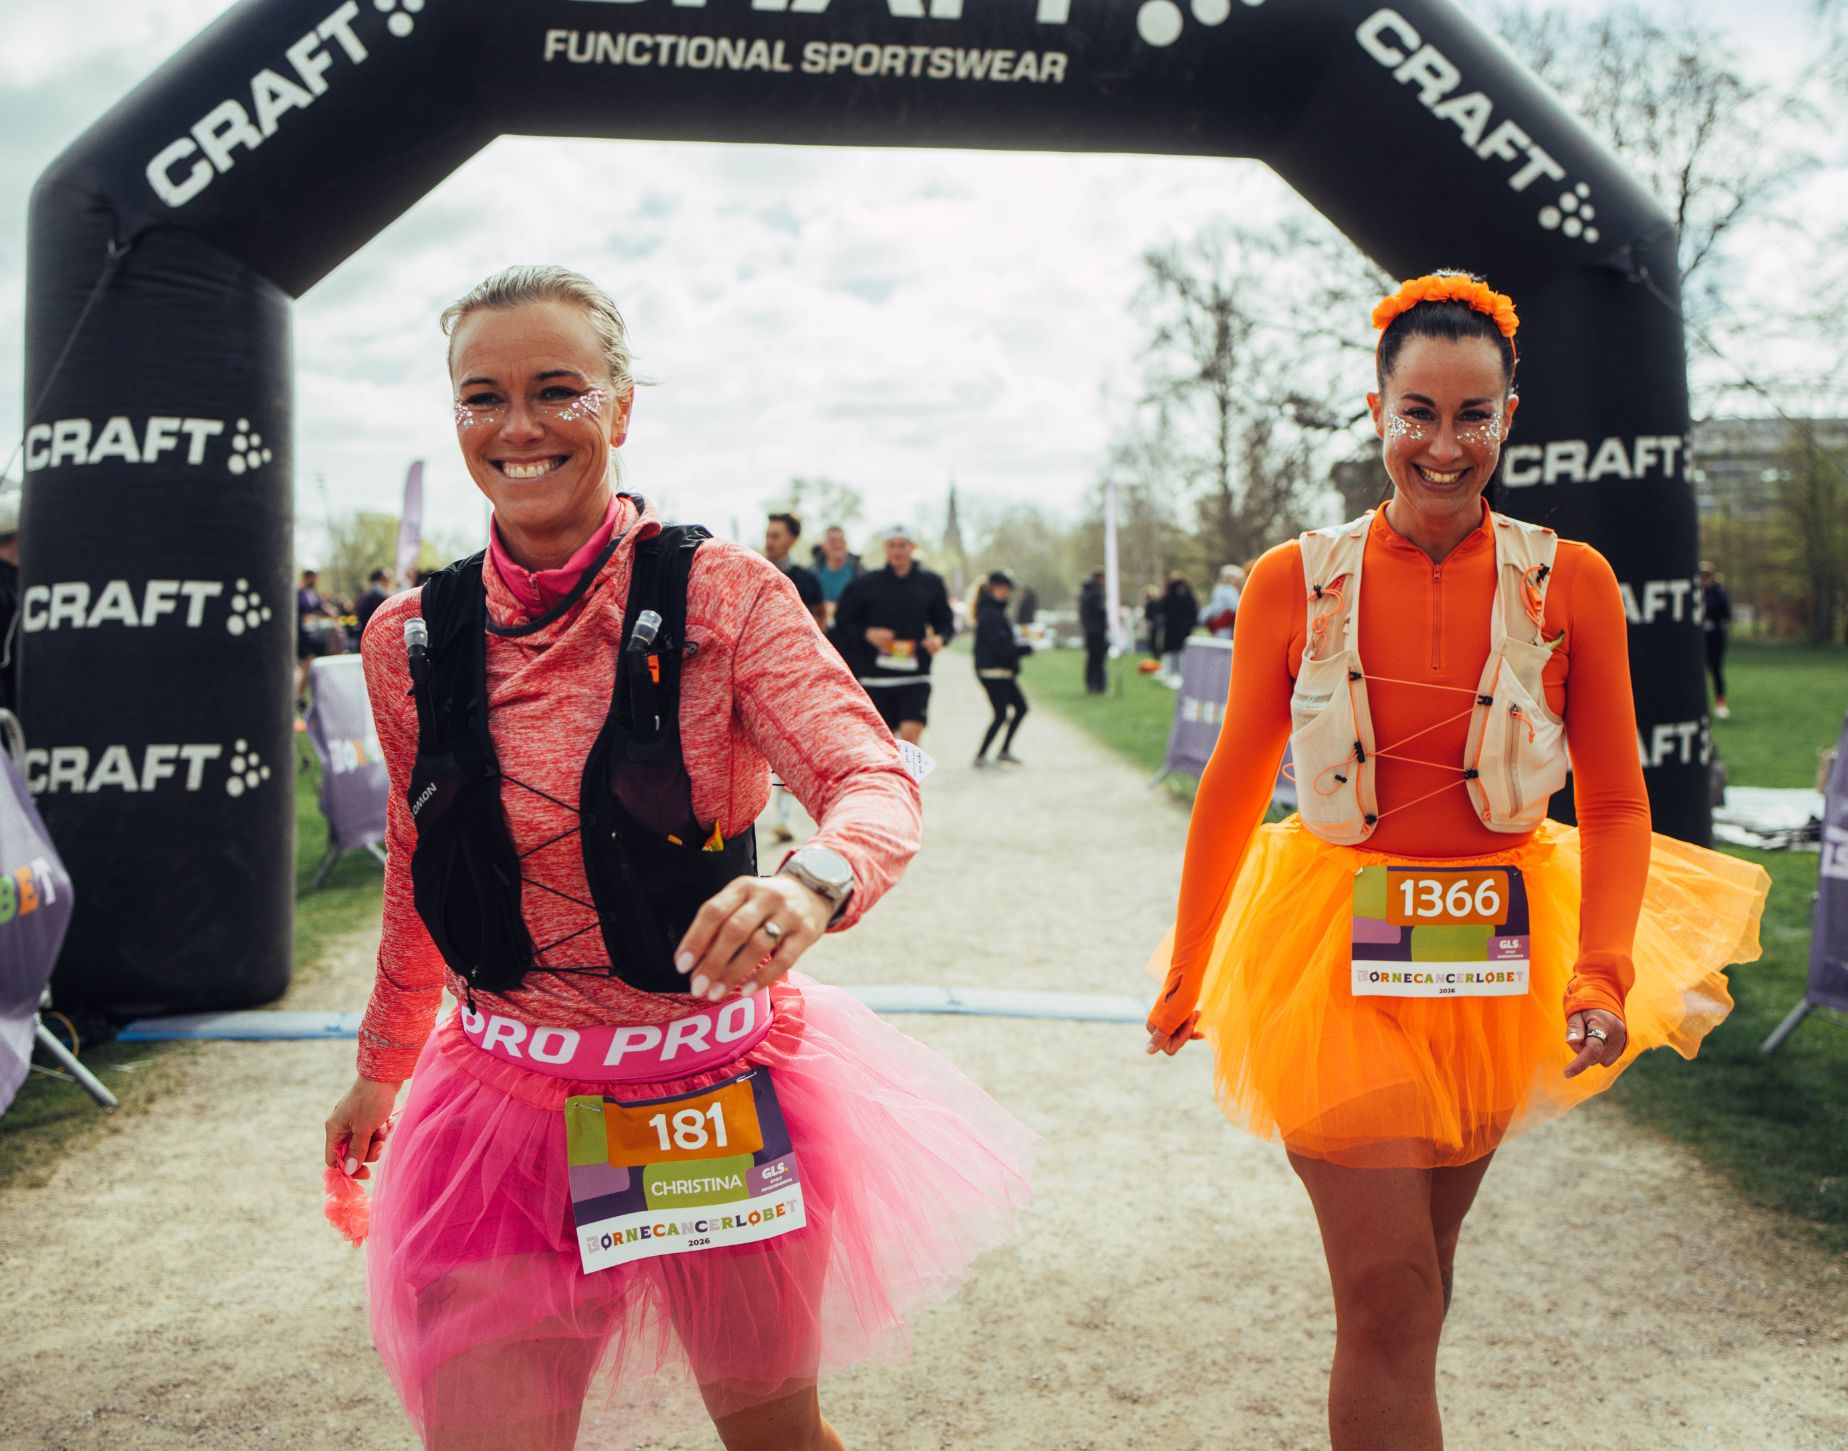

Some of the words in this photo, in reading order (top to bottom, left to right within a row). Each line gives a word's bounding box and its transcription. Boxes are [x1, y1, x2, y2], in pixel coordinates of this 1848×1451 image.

[543, 29, 792, 72] FUNCTIONAL
[801, 41, 1068, 83] SPORTSWEAR
[145, 0, 369, 208] CRAFT
[1355, 7, 1566, 192] CRAFT
[25, 416, 224, 472] CRAFT
[1502, 435, 1682, 487] CRAFT
[23, 579, 223, 633] CRAFT
[28, 744, 223, 794] CRAFT
[1399, 878, 1501, 918] 1366
[461, 1005, 581, 1065] PRO
[603, 997, 755, 1067] PRO
[649, 1101, 728, 1151] 181
[651, 1173, 743, 1197] CHRISTINA
[688, 1237, 711, 1247] 2026
